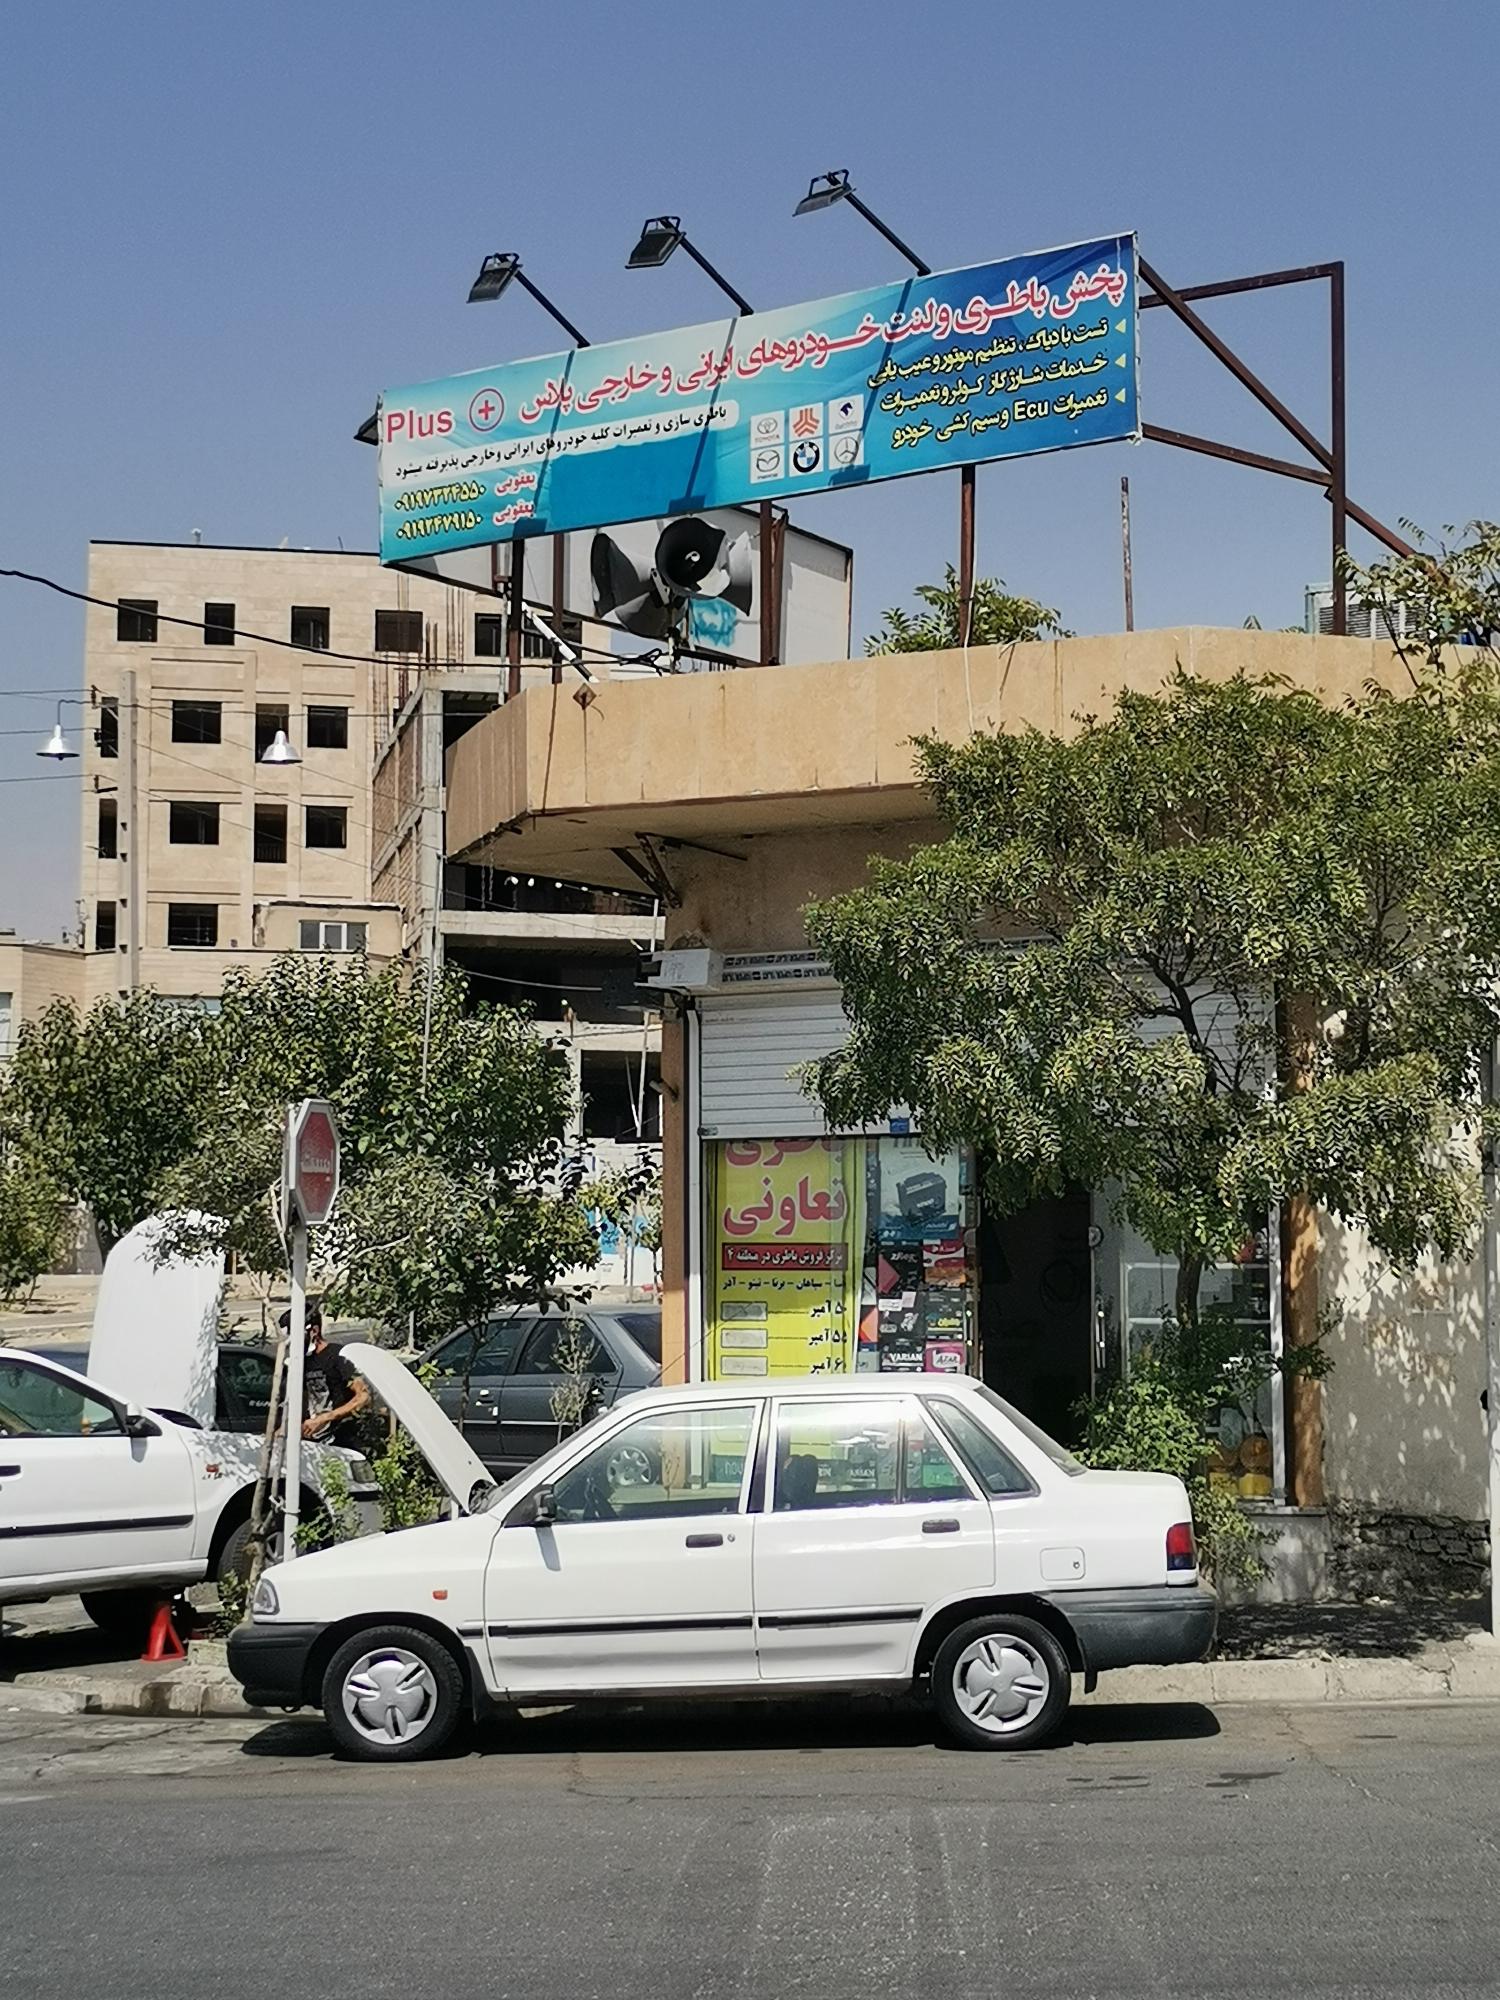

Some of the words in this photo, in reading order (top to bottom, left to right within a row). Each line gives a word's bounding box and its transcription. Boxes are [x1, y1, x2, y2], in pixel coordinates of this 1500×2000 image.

[1050, 265, 1126, 317] پخش
[954, 279, 1048, 332] باطری
[1061, 324, 1072, 347] با
[1073, 318, 1108, 342] تست
[737, 316, 881, 377] خودروهای
[975, 336, 1016, 367] تنظیم
[676, 346, 734, 391] ایرانی
[868, 358, 897, 387] یابی
[940, 347, 974, 373] موتور
[1045, 352, 1109, 380] خدمات
[948, 374, 985, 404] کولر
[987, 370, 1007, 395] گاز
[1006, 364, 1045, 392] شارژ
[521, 377, 574, 421] پلاس
[1013, 399, 1049, 420] Ecu
[1052, 387, 1108, 419] تعمیرات
[386, 410, 453, 443] Plus
[654, 422, 660, 434] و
[663, 413, 690, 433] سازی
[694, 405, 727, 427] باطری
[936, 411, 971, 441] کشی
[591, 427, 610, 443] کلیه
[613, 419, 652, 440] تعمیرات
[891, 420, 934, 449] خودرو
[504, 441, 534, 460] ایرانی
[536, 434, 587, 455] خودروهای
[426, 454, 459, 473] پذیرفته
[723, 1175, 846, 1236] تعاونی
[761, 1251, 771, 1265] در
[772, 1249, 798, 1265] باطری
[799, 1250, 824, 1265] فروش
[889, 1352, 923, 1362] VARIAN
